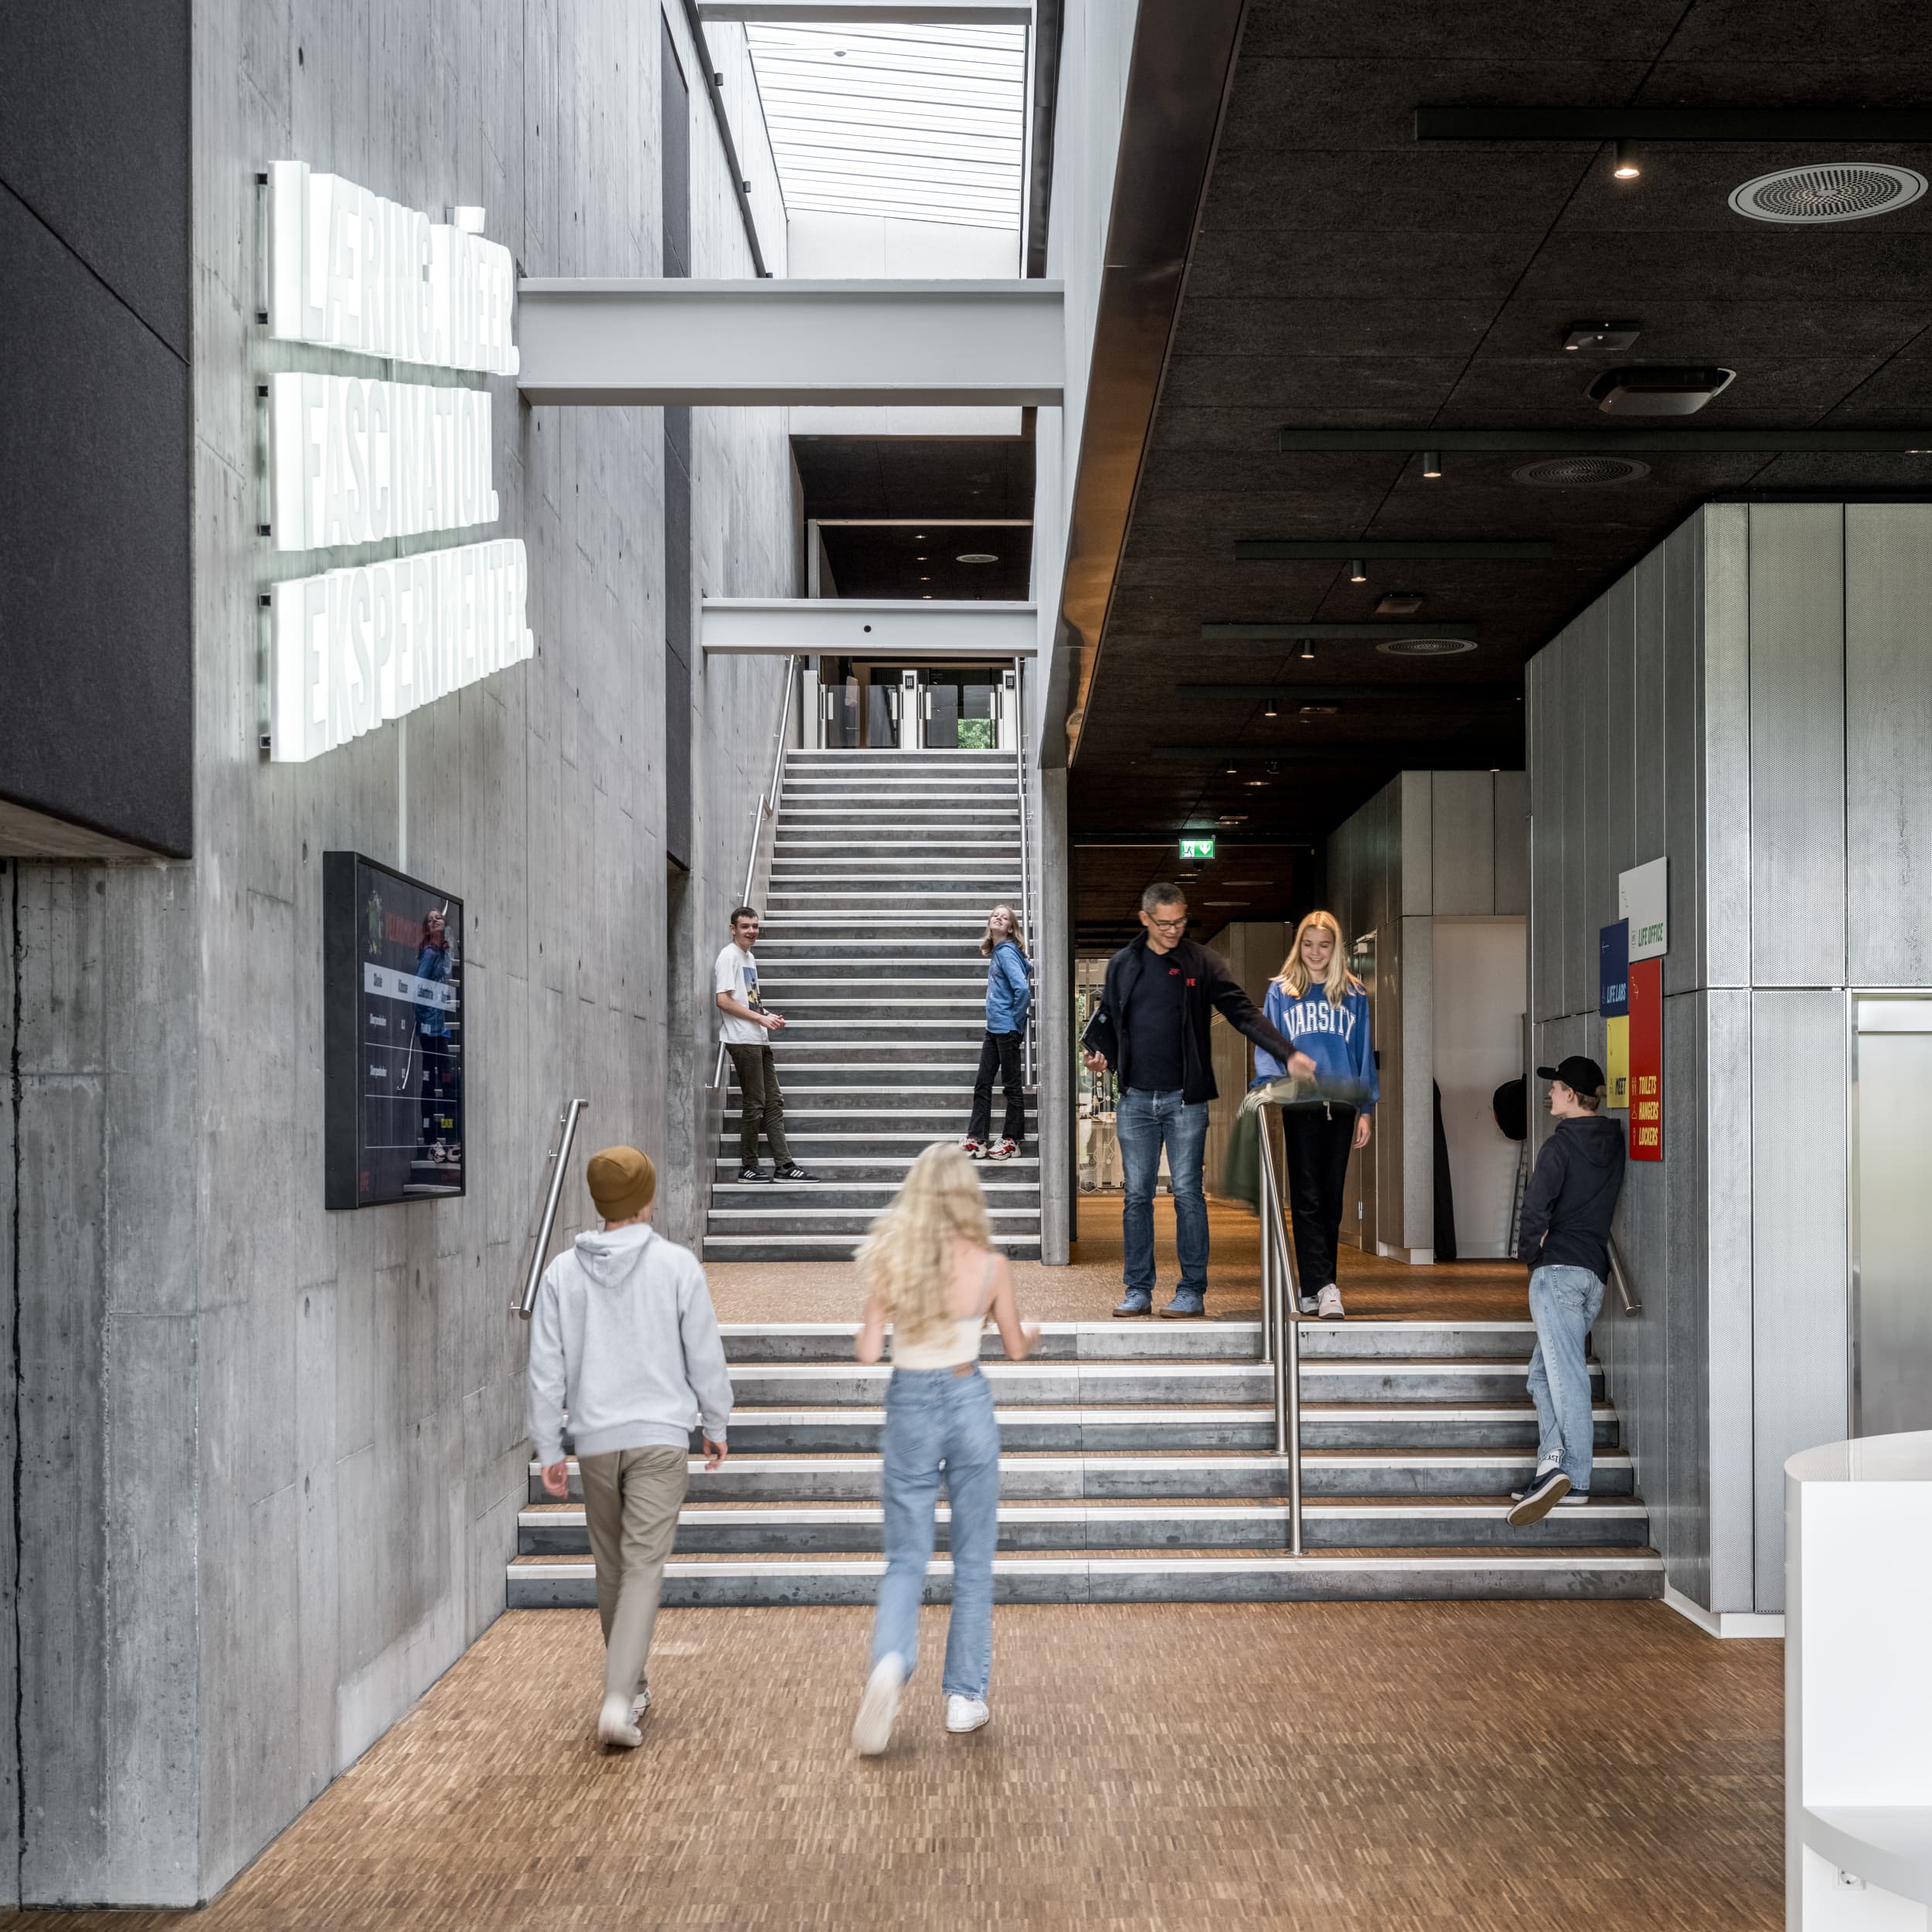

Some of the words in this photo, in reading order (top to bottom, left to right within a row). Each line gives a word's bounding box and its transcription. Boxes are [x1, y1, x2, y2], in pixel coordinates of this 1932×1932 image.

[274, 372, 498, 550] FASCINATION.
[274, 539, 534, 762] EKSPERIMENTER.
[1638, 927, 1648, 947] LIFE
[1648, 922, 1663, 944] OFFICE
[1186, 978, 1196, 987] FE
[1607, 985, 1616, 1004] LIFE
[1615, 982, 1626, 1002] LABS
[1283, 1000, 1356, 1044] VARSITY
[1615, 1077, 1627, 1095] MEET
[1639, 1075, 1657, 1095] TOILETS
[1638, 1100, 1659, 1121] HANGERS
[1638, 1126, 1658, 1146] LOCKERS
